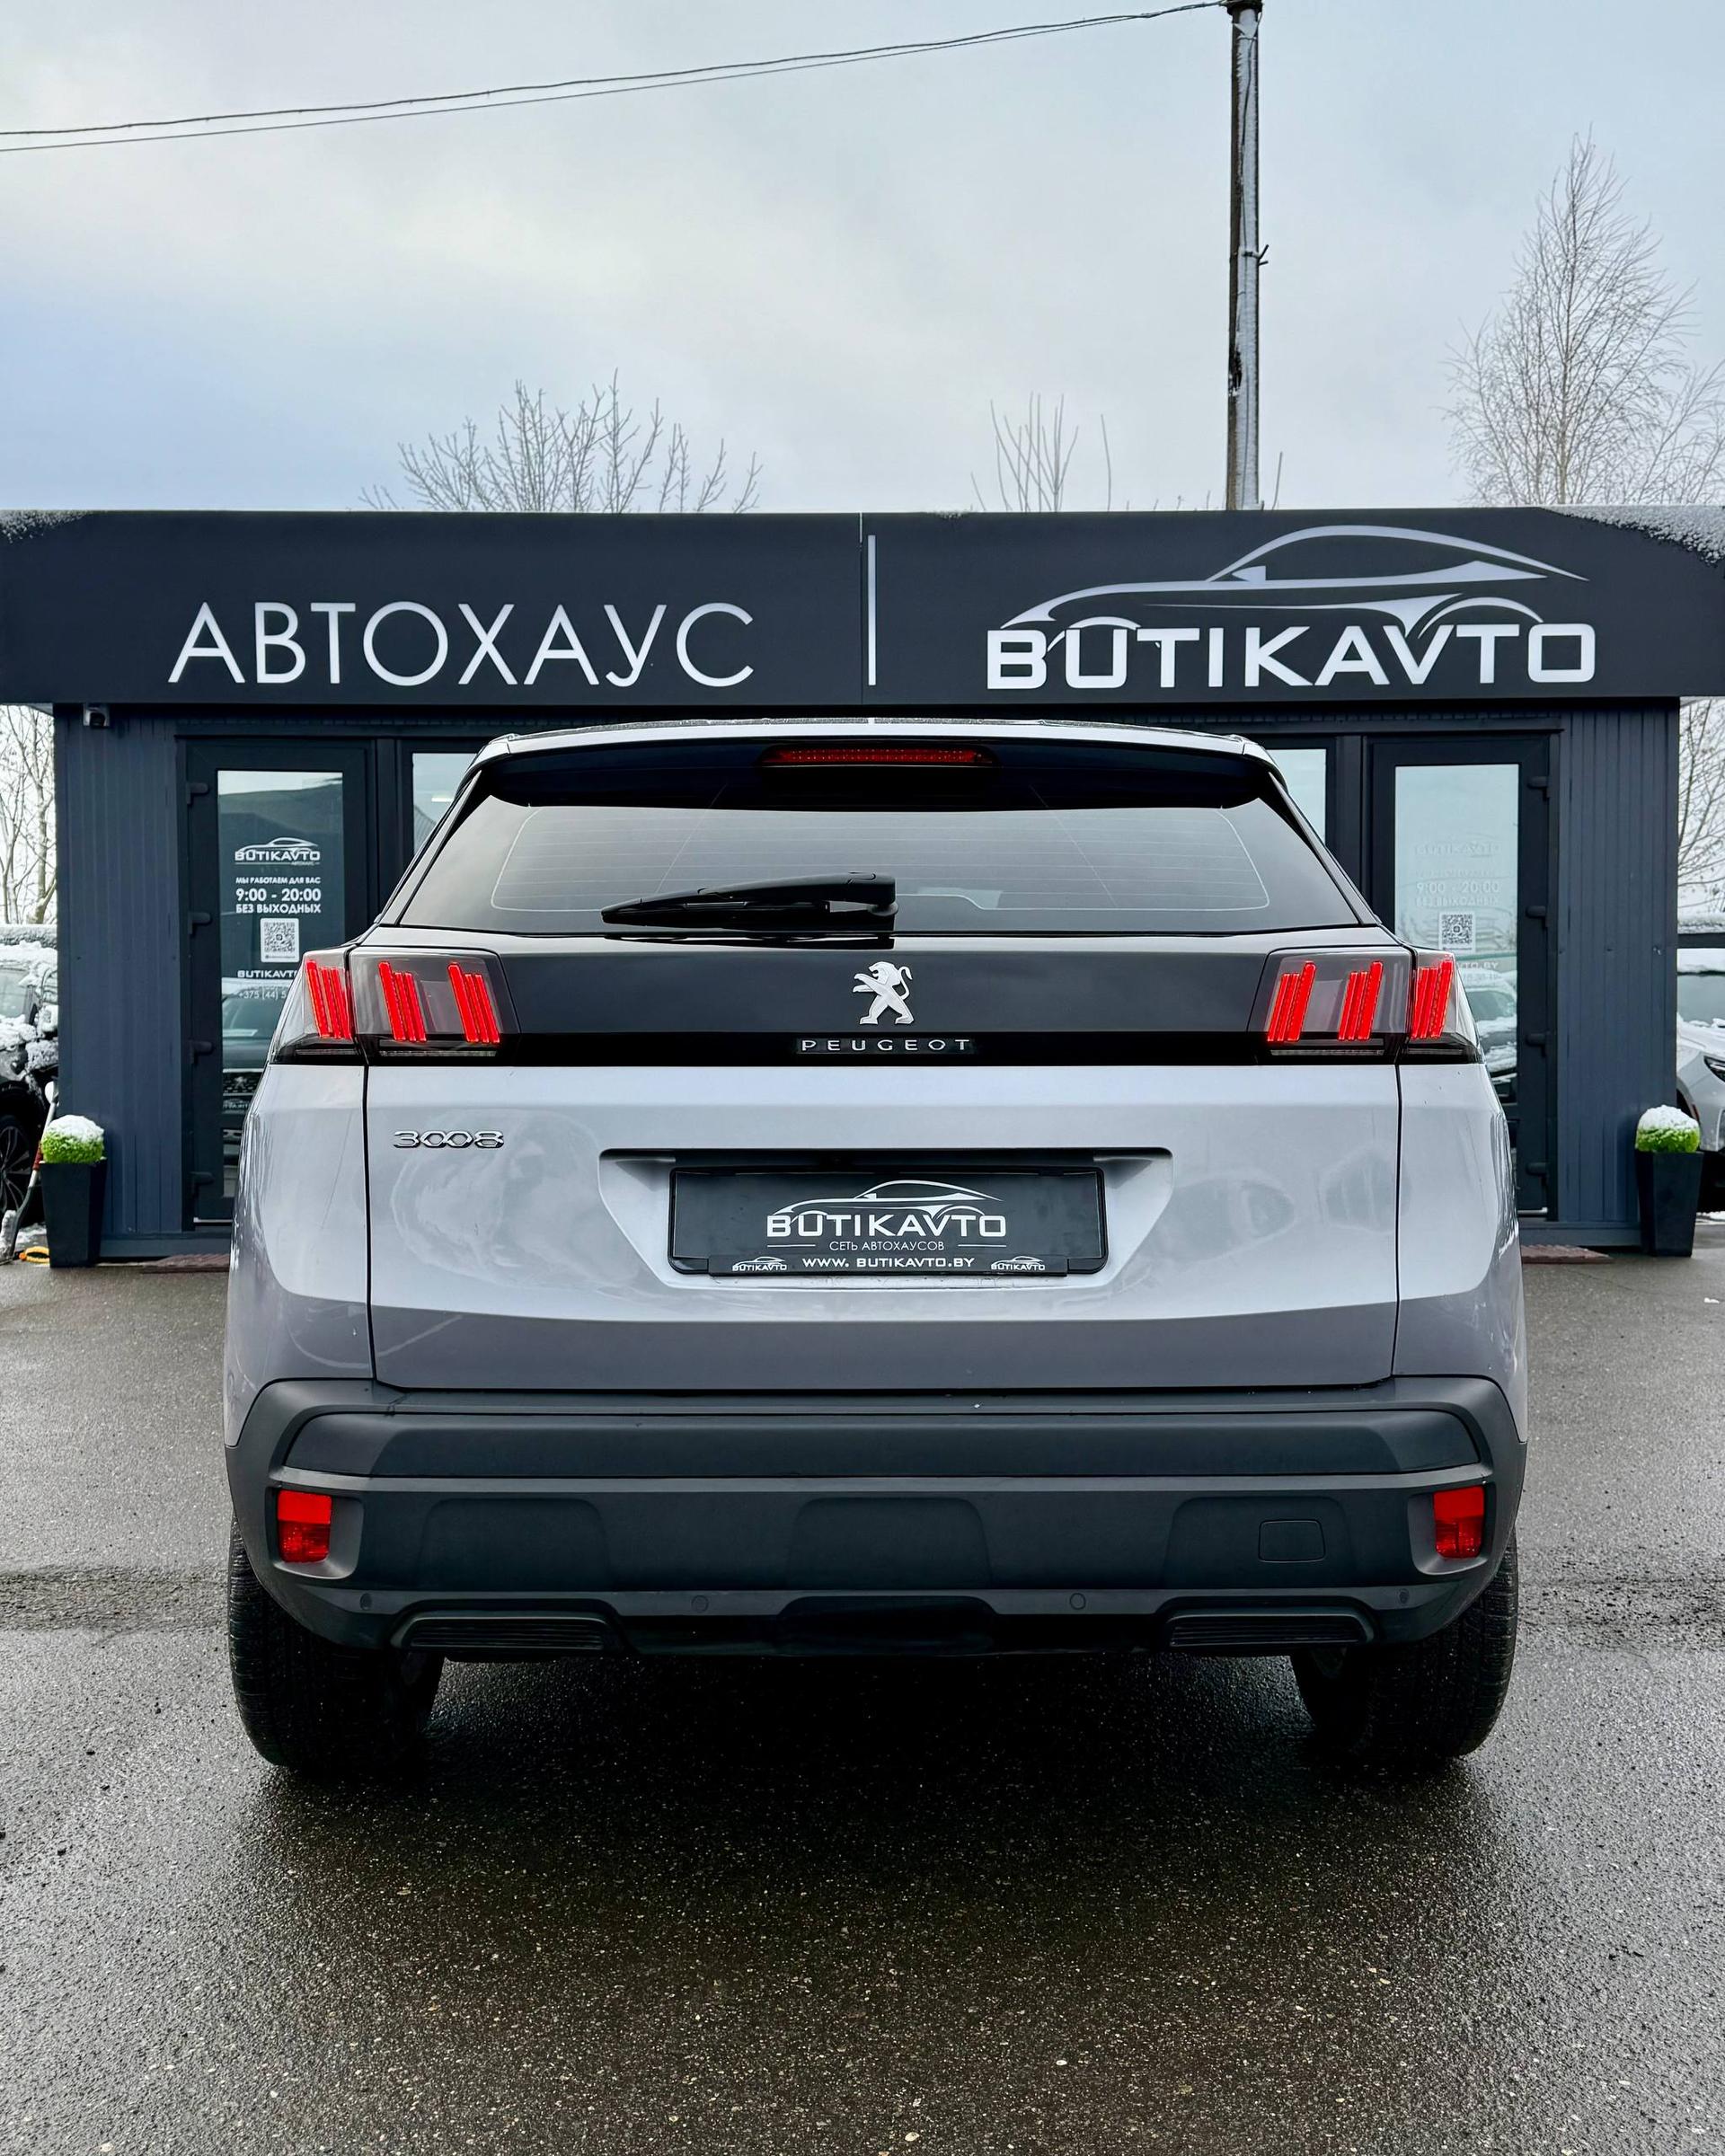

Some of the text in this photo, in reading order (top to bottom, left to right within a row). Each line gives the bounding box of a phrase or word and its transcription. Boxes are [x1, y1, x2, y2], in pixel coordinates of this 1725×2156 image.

[168, 601, 754, 687] АВТОХАУС
[987, 623, 1596, 689] BUTIKAVTO
[234, 850, 321, 862] BUTIKAVTO
[288, 877, 304, 885] ДЛЯ
[235, 888, 267, 902] 9:00
[281, 888, 322, 902] 20:00
[235, 904, 322, 915] БЕЗ ВЫХОДНЫХ
[801, 1039, 970, 1051] PEUGEOT
[394, 1131, 505, 1149] 3008
[766, 1214, 1007, 1238] BUTIKAVTO
[829, 1241, 944, 1251] СЕТЬ АВТОХАУСОВ
[802, 1258, 975, 1268] WWW. BUTIKAVTO.BY
[990, 1263, 1046, 1271] BUTIKAVTO
